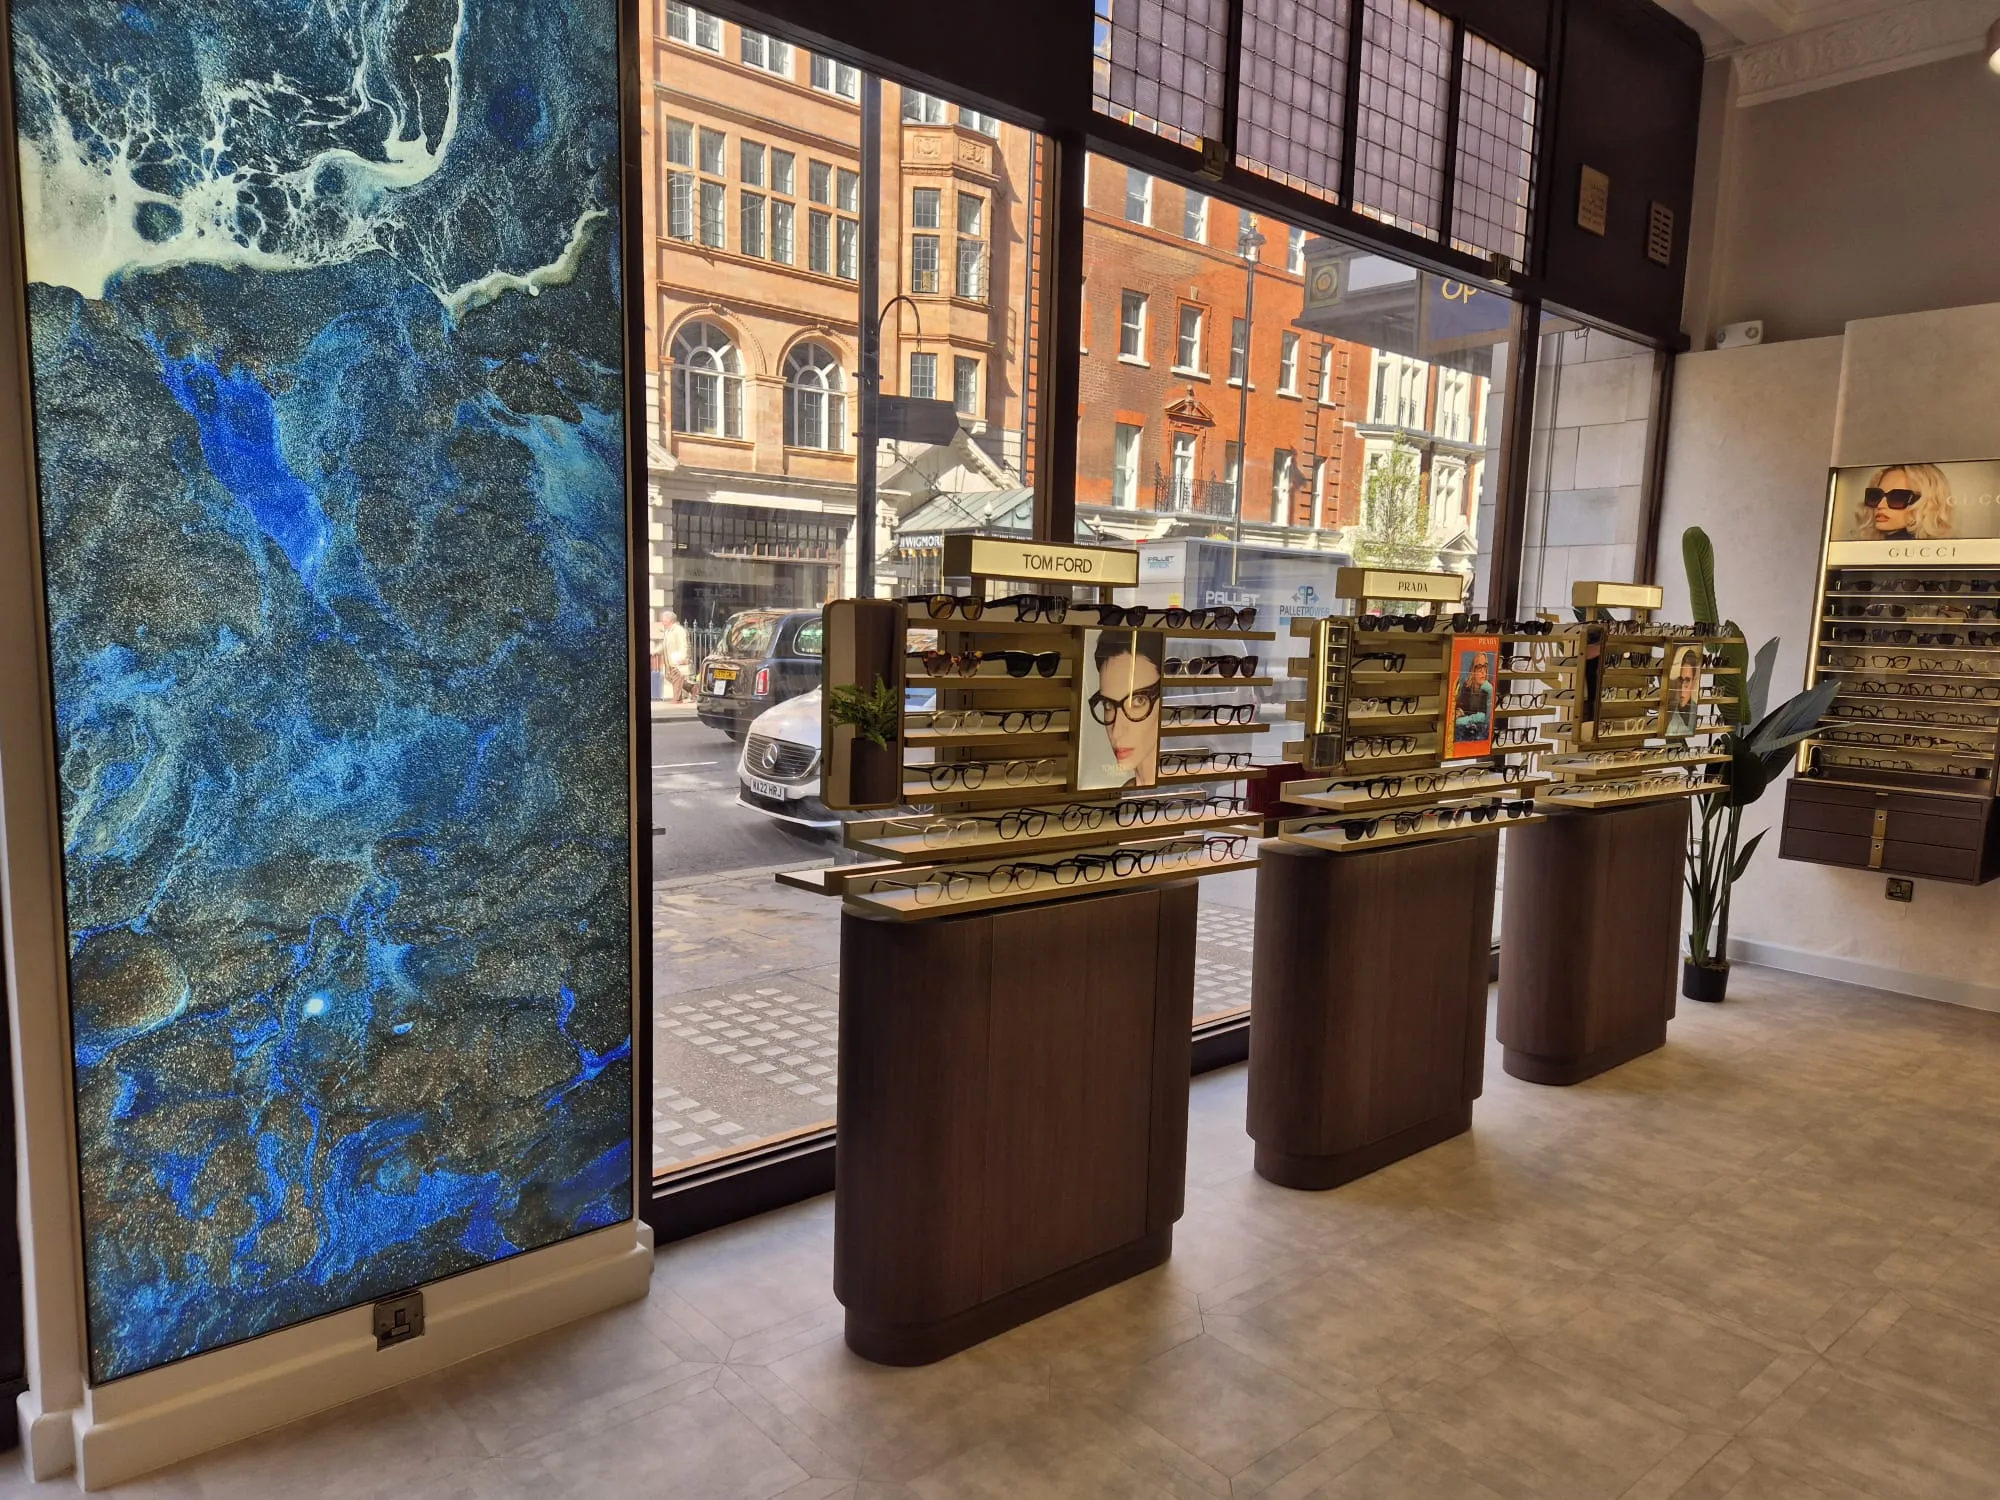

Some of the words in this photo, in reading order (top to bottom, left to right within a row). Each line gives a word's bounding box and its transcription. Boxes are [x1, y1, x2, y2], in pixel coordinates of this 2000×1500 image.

[1888, 547, 1956, 558] GUCCI
[1022, 553, 1053, 571] TOM
[1055, 556, 1093, 574] FORD
[1398, 581, 1429, 593] PRADA
[1205, 590, 1261, 607] PALLET
[1478, 638, 1497, 646] PRADA
